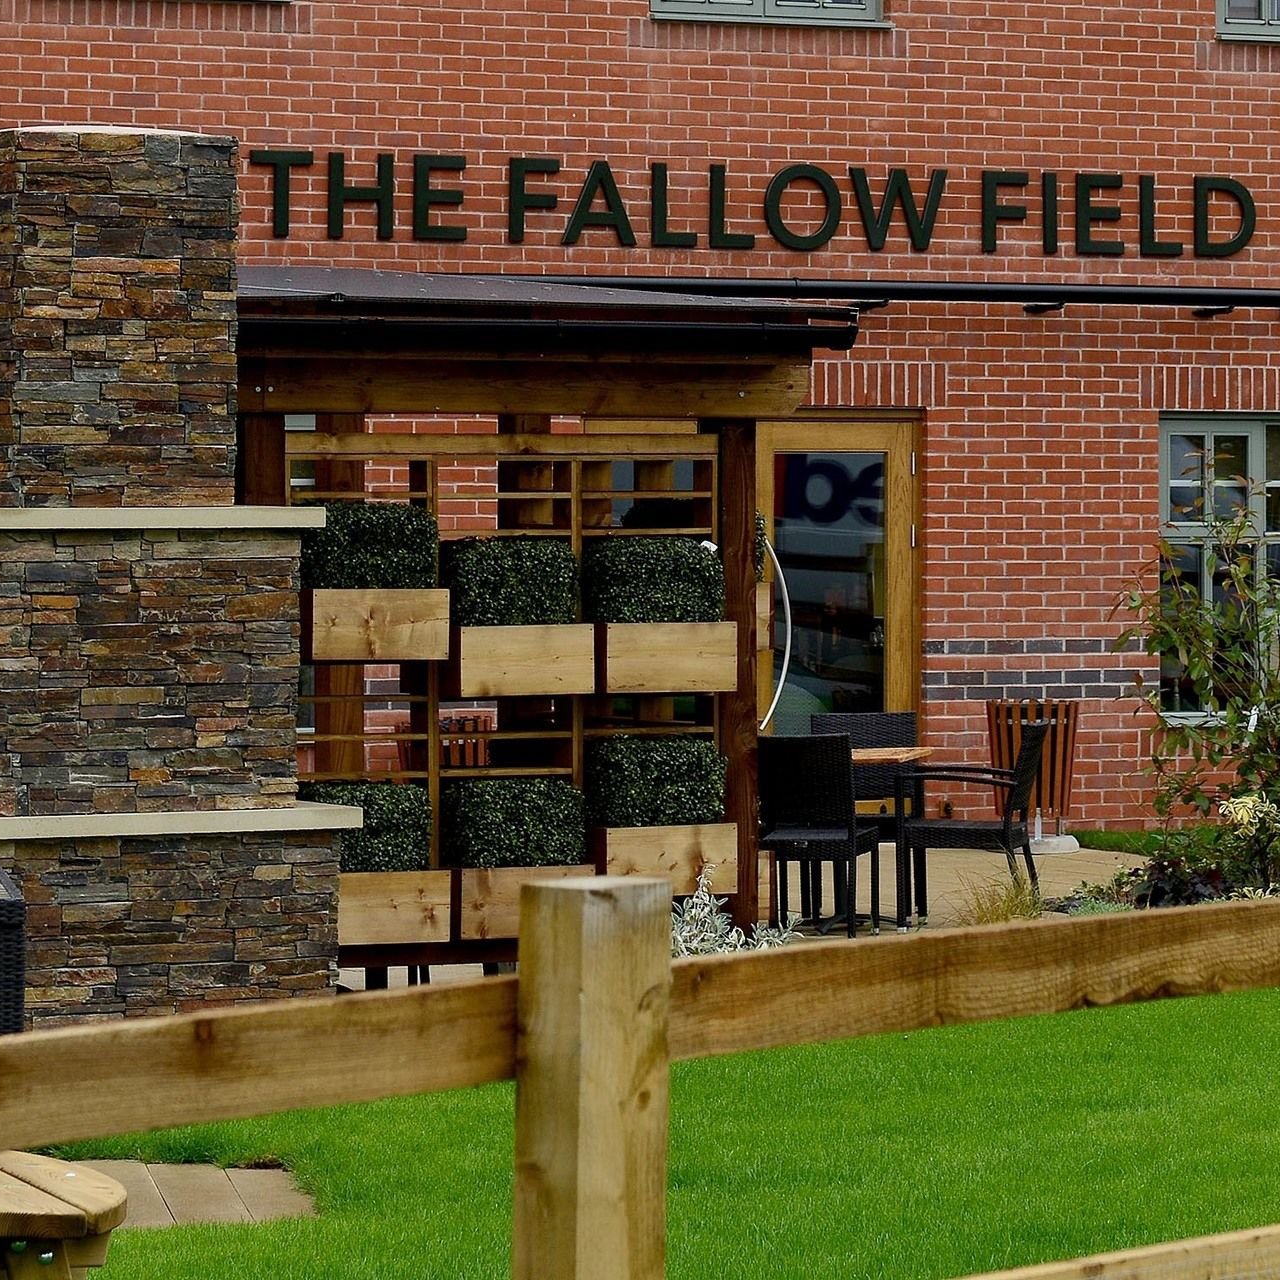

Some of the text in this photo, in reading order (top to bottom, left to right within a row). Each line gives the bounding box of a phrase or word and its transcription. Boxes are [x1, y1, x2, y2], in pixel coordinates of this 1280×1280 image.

[249, 150, 1257, 259] THE FALLOW FIELD
